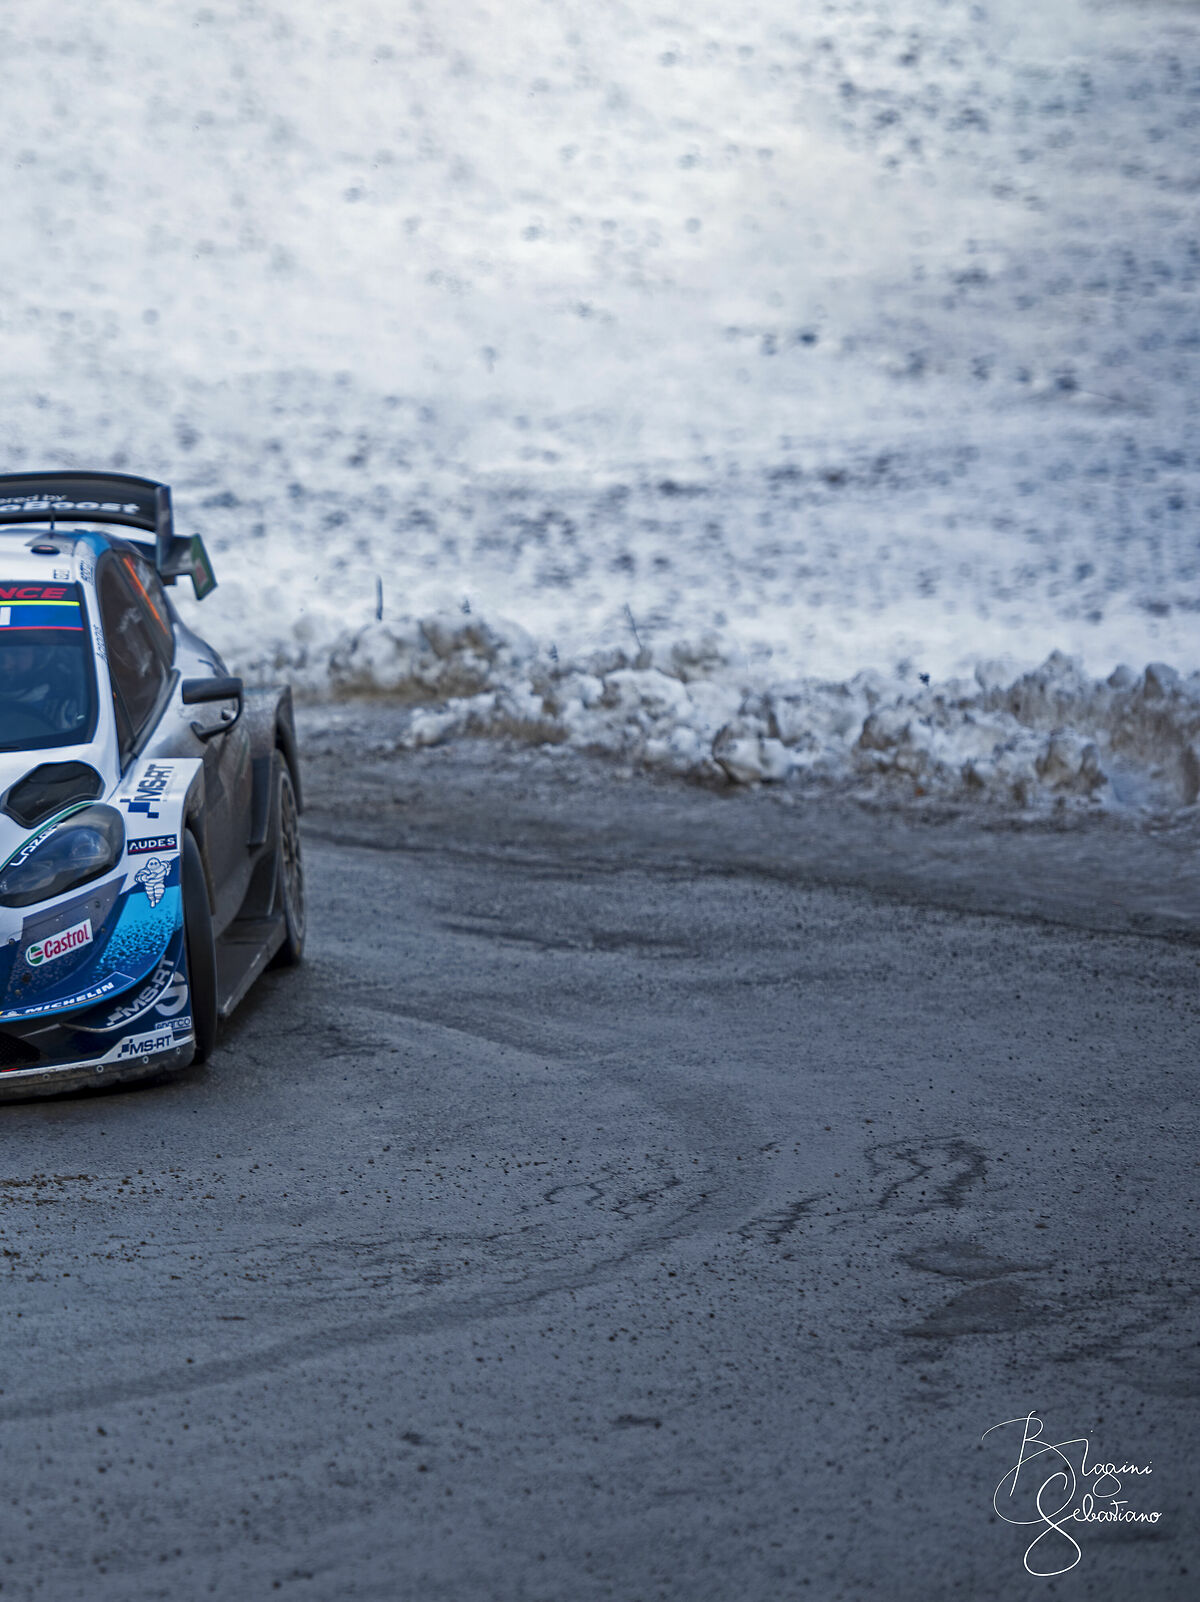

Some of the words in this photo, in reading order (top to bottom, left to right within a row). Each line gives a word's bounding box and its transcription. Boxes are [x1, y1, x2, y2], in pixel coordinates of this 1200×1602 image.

[42, 494, 66, 502] by
[128, 837, 176, 851] AUDES
[43, 924, 91, 960] Castrol
[25, 982, 115, 1014] MICHELIN
